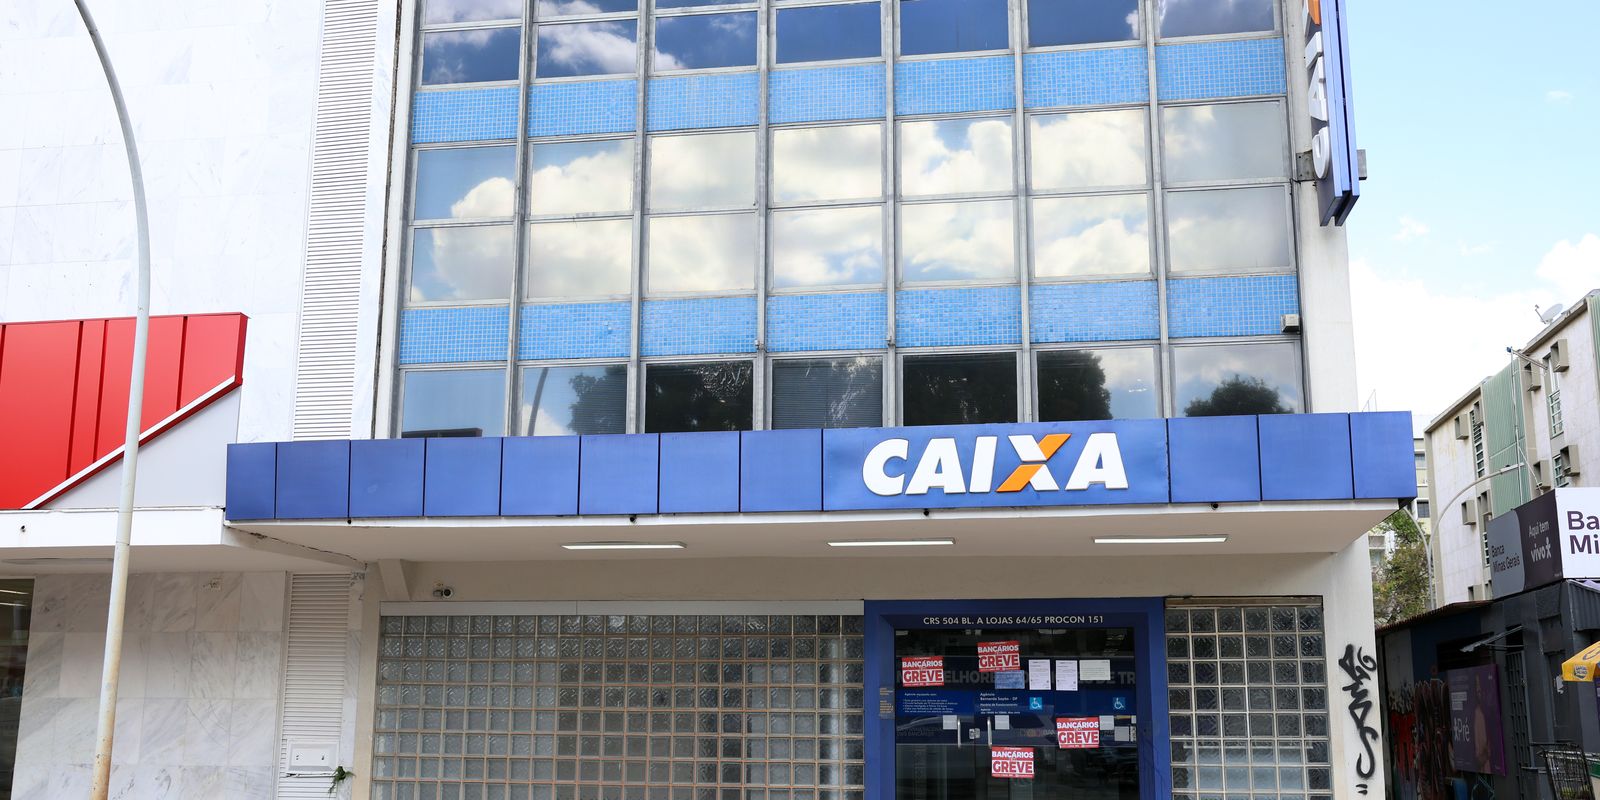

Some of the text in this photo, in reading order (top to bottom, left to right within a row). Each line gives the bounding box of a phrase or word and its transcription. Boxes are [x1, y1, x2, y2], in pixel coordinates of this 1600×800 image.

[862, 432, 1129, 496] CAIXA
[1567, 510, 1600, 531] Ba
[1528, 520, 1550, 539] Aqui tem
[1569, 534, 1600, 554] Mi
[1491, 544, 1505, 558] Banca
[1530, 543, 1545, 563] vivo
[1492, 552, 1520, 573] Minas Gerais
[923, 615, 1104, 625] CRS 504 BL. A LOJAS 64/65 PROCON 151
[978, 645, 1019, 653] BANCÁRIOS
[902, 659, 943, 668] BANCÁRIOS
[979, 655, 1019, 667] GREVE
[903, 670, 943, 682] GREVE
[1056, 721, 1099, 730] BANCÁRIOS
[1058, 731, 1099, 743] GREVE
[991, 751, 1034, 759] BANCÁRIOS
[993, 761, 1033, 773] GREVE
